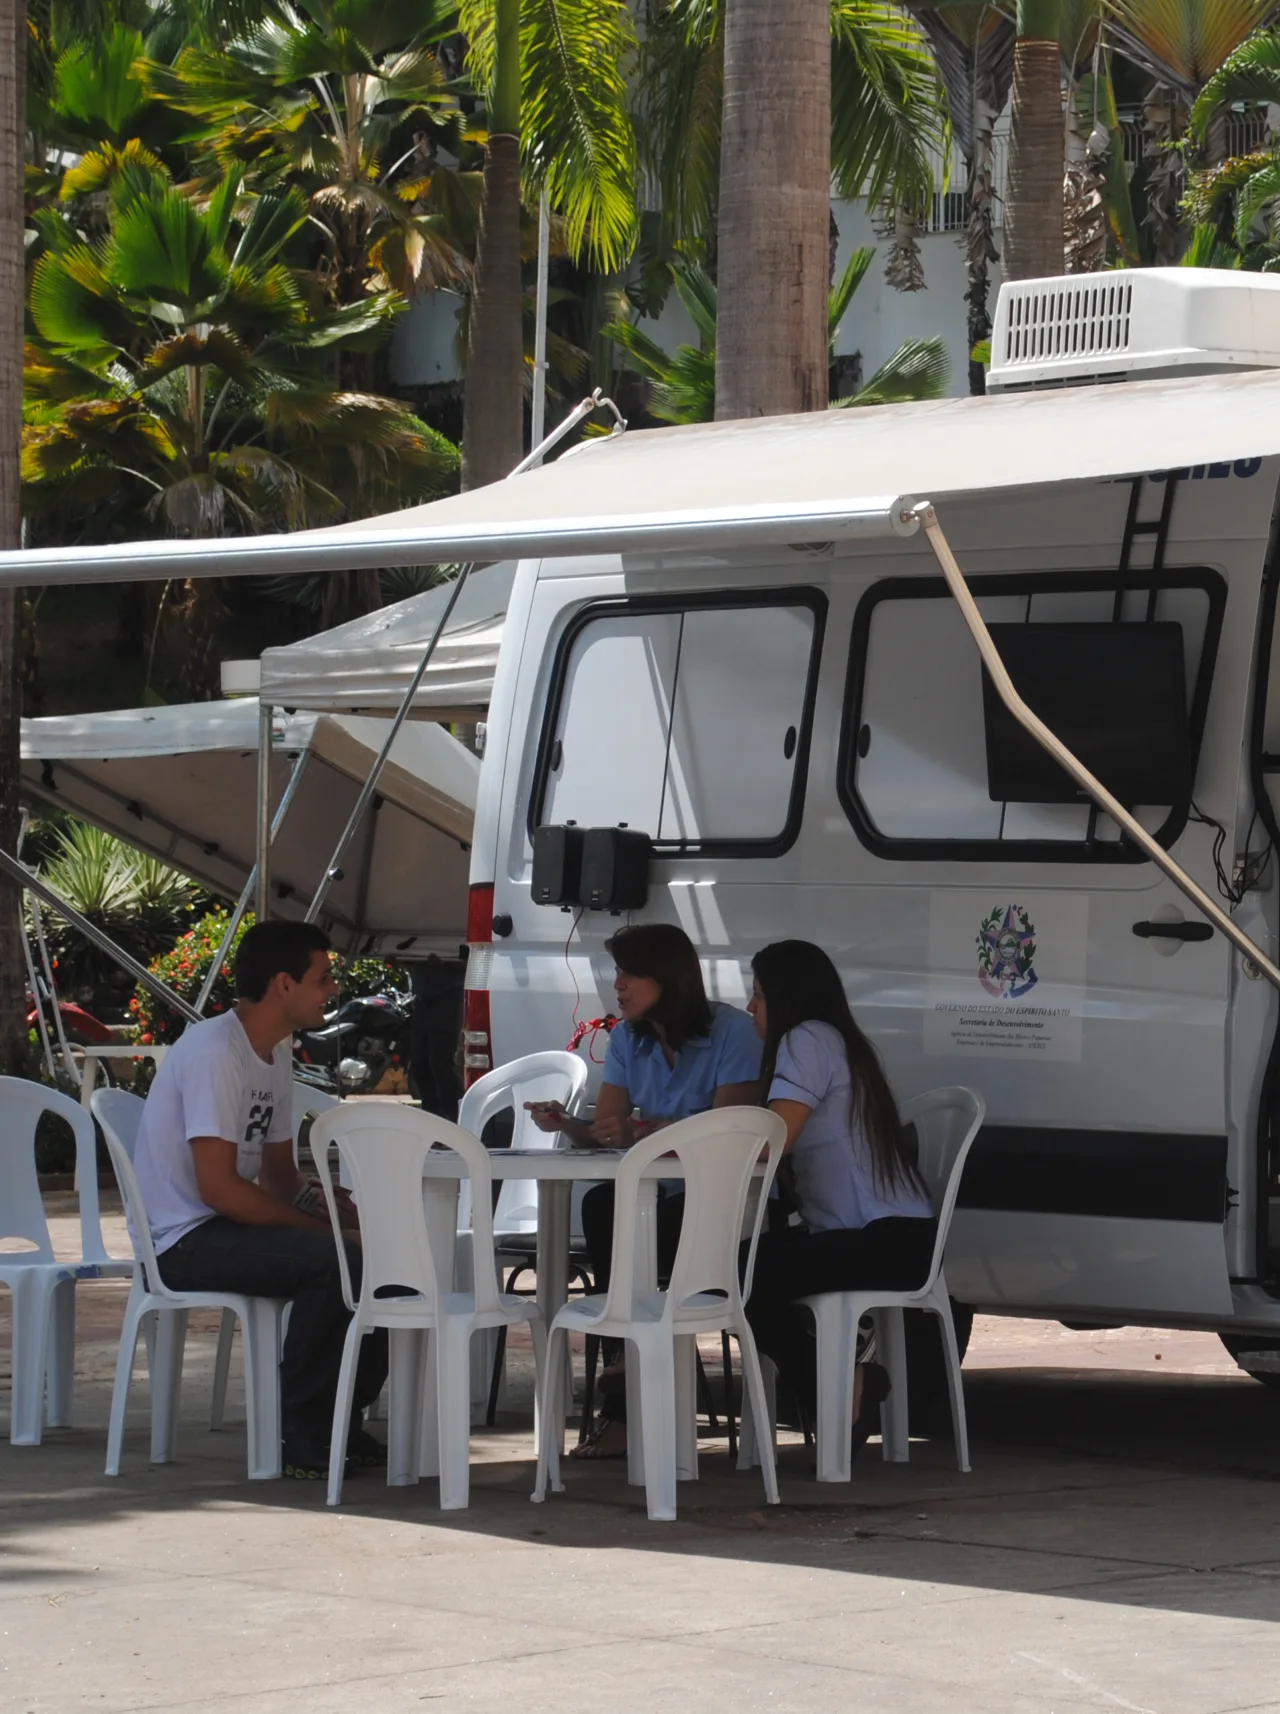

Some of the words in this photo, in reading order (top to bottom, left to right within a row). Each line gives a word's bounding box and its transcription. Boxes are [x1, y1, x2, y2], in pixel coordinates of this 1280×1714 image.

[935, 1003, 967, 1012] GOVERNO
[967, 1005, 978, 1013] DO
[978, 1005, 1004, 1014] ESTADO
[1005, 1006, 1016, 1015] DO
[1047, 1008, 1070, 1017] SANTO
[959, 1017, 987, 1026] Secretaria
[988, 1018, 995, 1027] de
[996, 1019, 1044, 1028] Desenvolvimento
